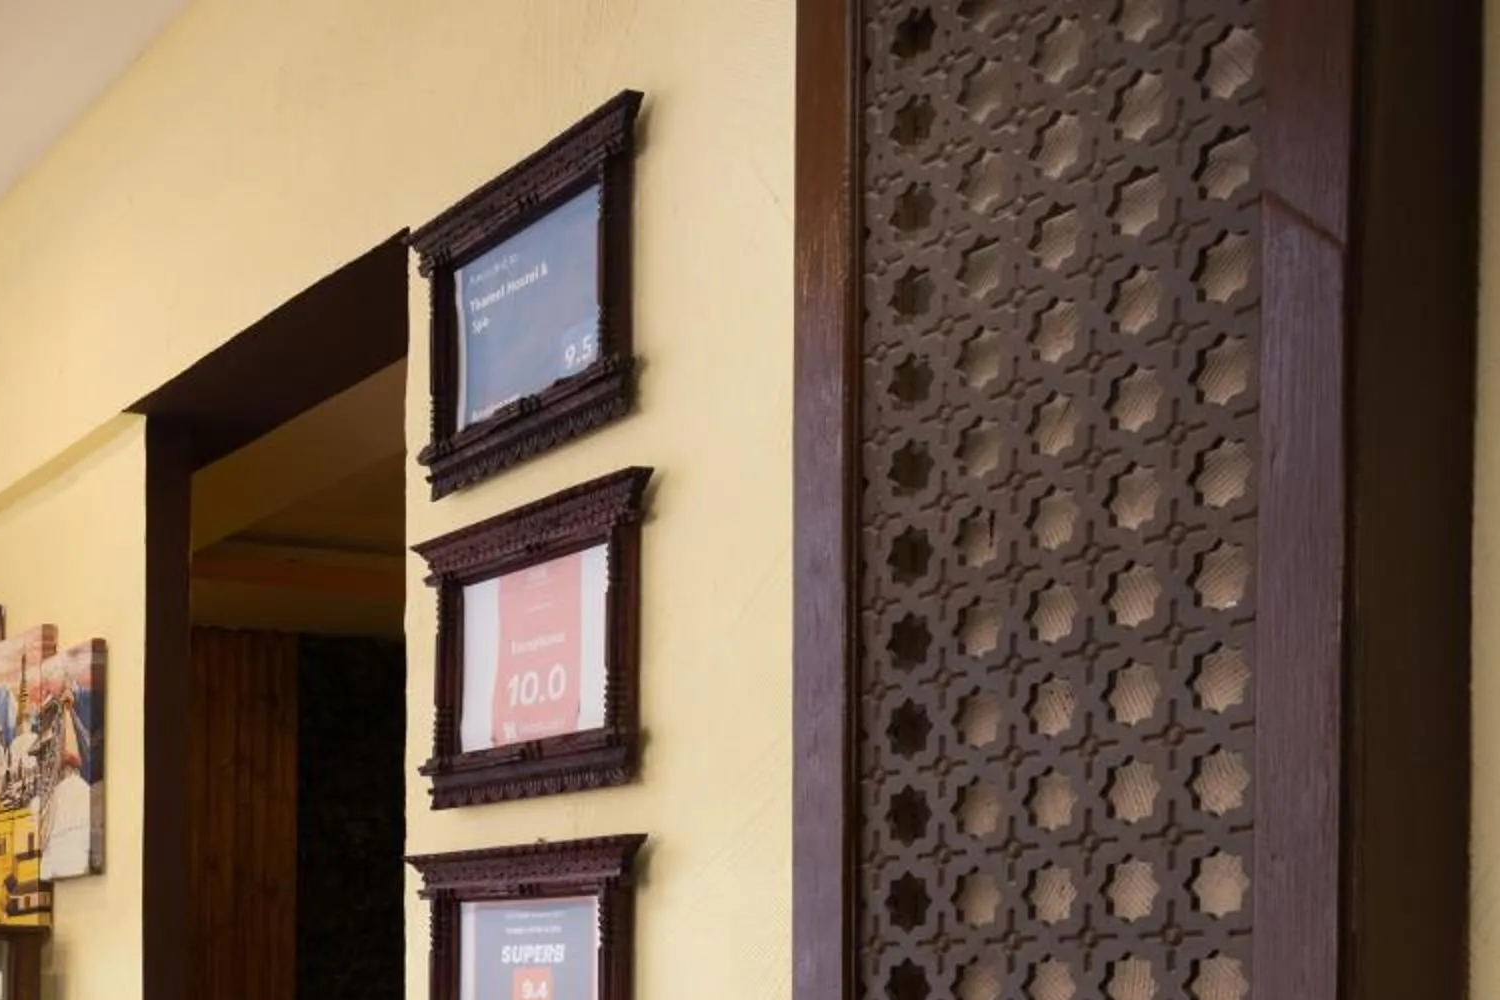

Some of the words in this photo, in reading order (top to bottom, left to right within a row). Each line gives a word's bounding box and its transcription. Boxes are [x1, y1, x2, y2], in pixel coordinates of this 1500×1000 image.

[564, 335, 593, 369] 9.5
[507, 664, 567, 707] 10.0
[501, 943, 566, 964] SUPERB
